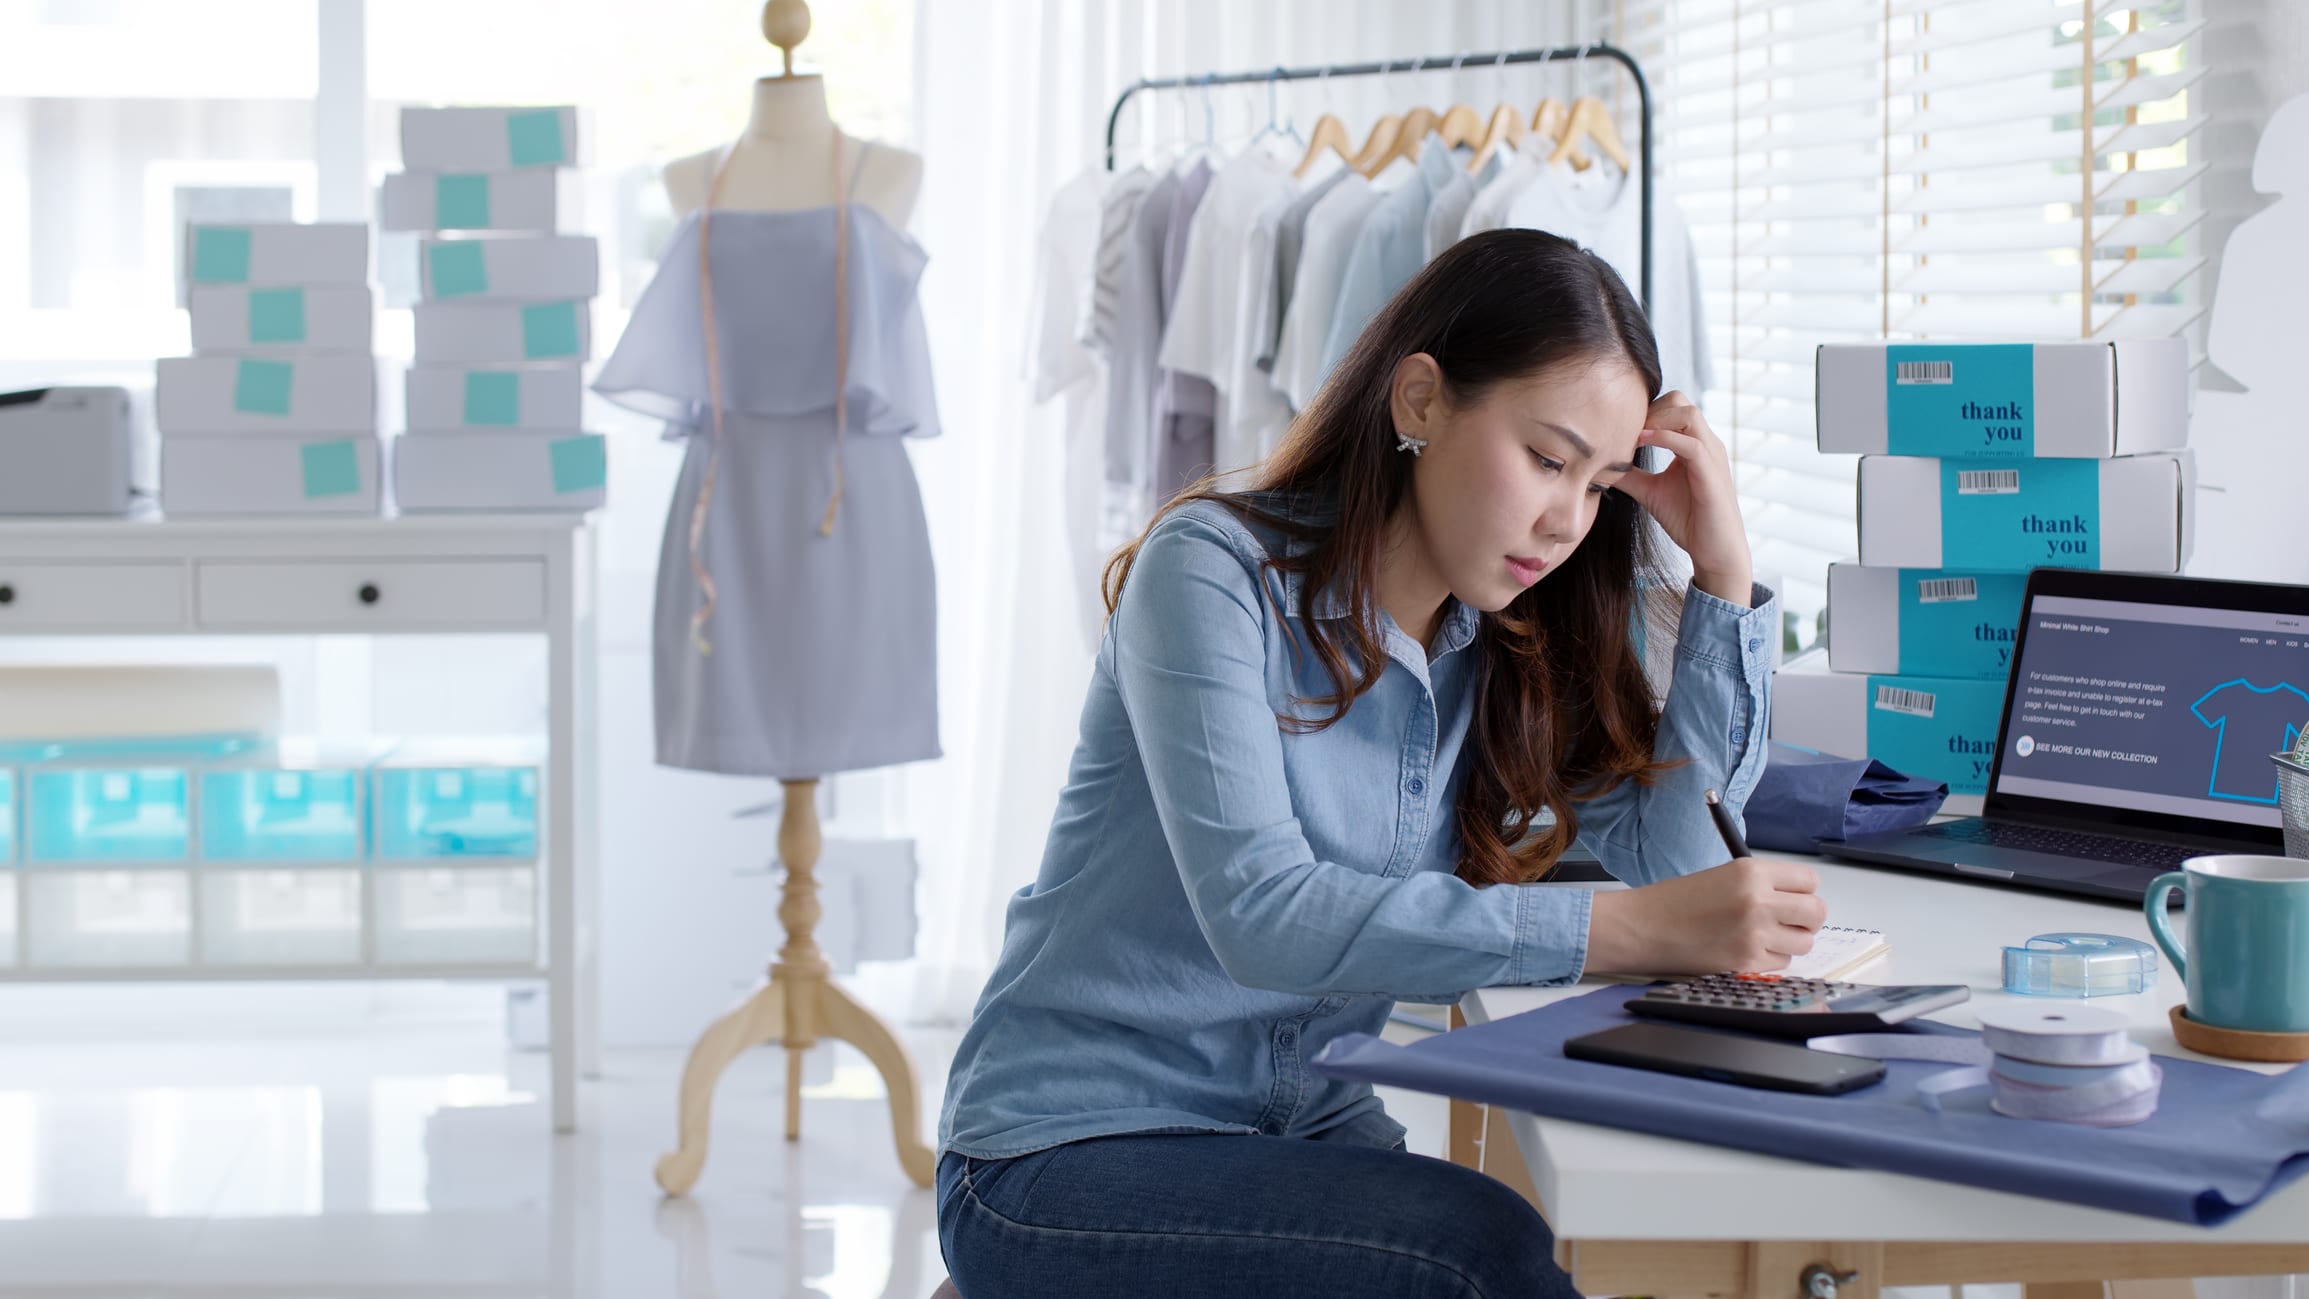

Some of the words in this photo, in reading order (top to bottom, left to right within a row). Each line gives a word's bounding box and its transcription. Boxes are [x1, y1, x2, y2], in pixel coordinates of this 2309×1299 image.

[1961, 401, 2023, 420] thank
[1985, 426, 2022, 446] you
[2022, 514, 2087, 533] thank
[2047, 540, 2087, 559] you
[2040, 621, 2061, 630] Minimal
[2062, 622, 2079, 631] White
[2080, 624, 2093, 632] Shirt
[2094, 625, 2110, 634] Shop
[2239, 637, 2259, 645] WOMEN
[2031, 671, 2041, 680] For
[2042, 673, 2074, 683] customers
[2090, 678, 2106, 688] shop
[2107, 680, 2127, 688] online
[2128, 682, 2141, 690] and
[2142, 683, 2166, 693] require
[2027, 687, 2043, 695] e-tax
[2044, 688, 2067, 697] invoice
[2068, 690, 2081, 698] and
[2081, 692, 2104, 700] unable
[2105, 694, 2112, 702] to
[2112, 695, 2137, 704] register
[2138, 697, 2145, 705] at
[2146, 698, 2163, 706] e-tax
[2025, 701, 2043, 710] page.
[2044, 701, 2058, 710] Feel
[2059, 702, 2072, 711] free
[2072, 704, 2080, 712] to
[2080, 706, 2091, 715] get
[2092, 706, 2099, 715] in
[2100, 708, 2118, 717] touch
[2119, 710, 2133, 718] with
[2022, 715, 2052, 723] customer
[2052, 718, 2077, 727] service.
[1949, 735, 1997, 754] than
[2036, 742, 2051, 752] SEE
[2051, 744, 2074, 755] MORE
[2074, 747, 2092, 757] OUR
[2092, 748, 2111, 759] NEW
[2111, 751, 2158, 764] COLLECTION
